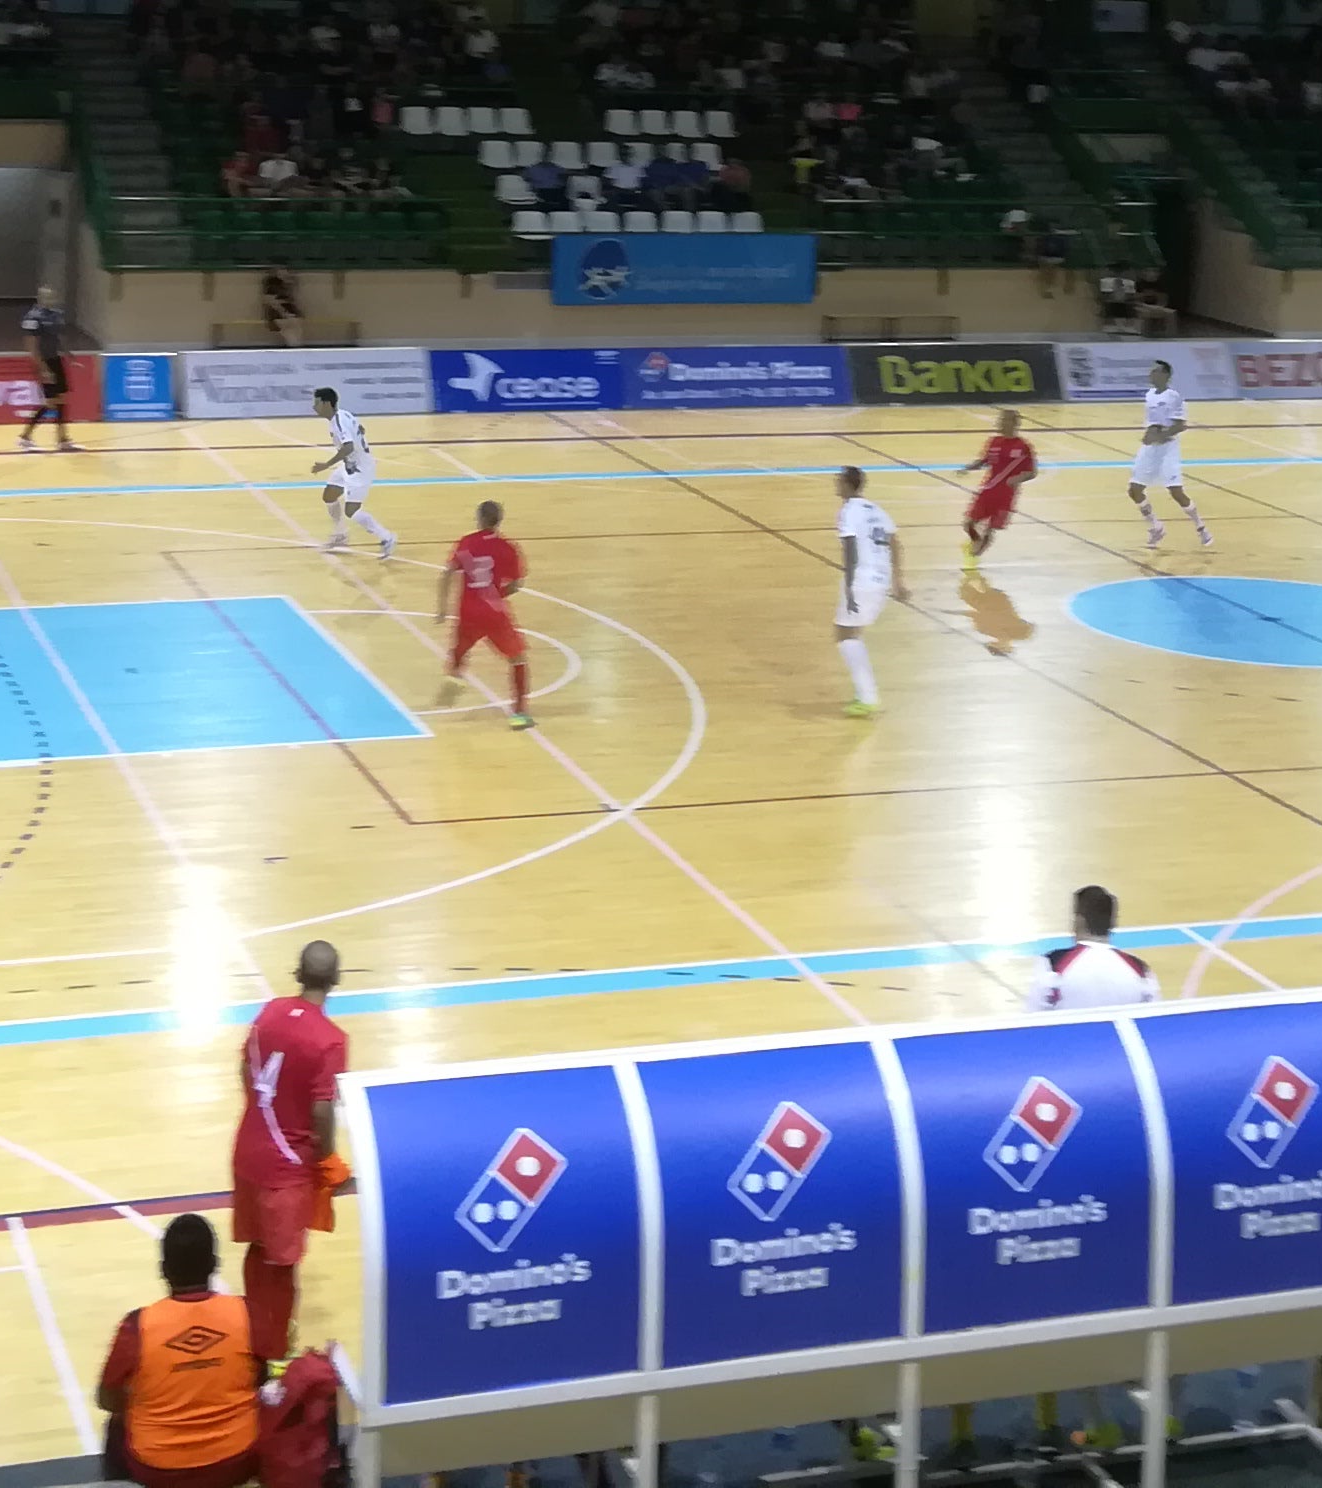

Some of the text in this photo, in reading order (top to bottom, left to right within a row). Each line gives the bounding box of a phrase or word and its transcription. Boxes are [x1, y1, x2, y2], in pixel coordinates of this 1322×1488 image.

[967, 1194, 1108, 1235] Domino's
[1240, 1209, 1322, 1239] Pizza
[710, 1222, 858, 1266] Domino's
[996, 1235, 1081, 1265] Pizza
[436, 1253, 592, 1299] Domino's
[741, 1265, 829, 1296] Pizza
[468, 1298, 563, 1330] Pizza
